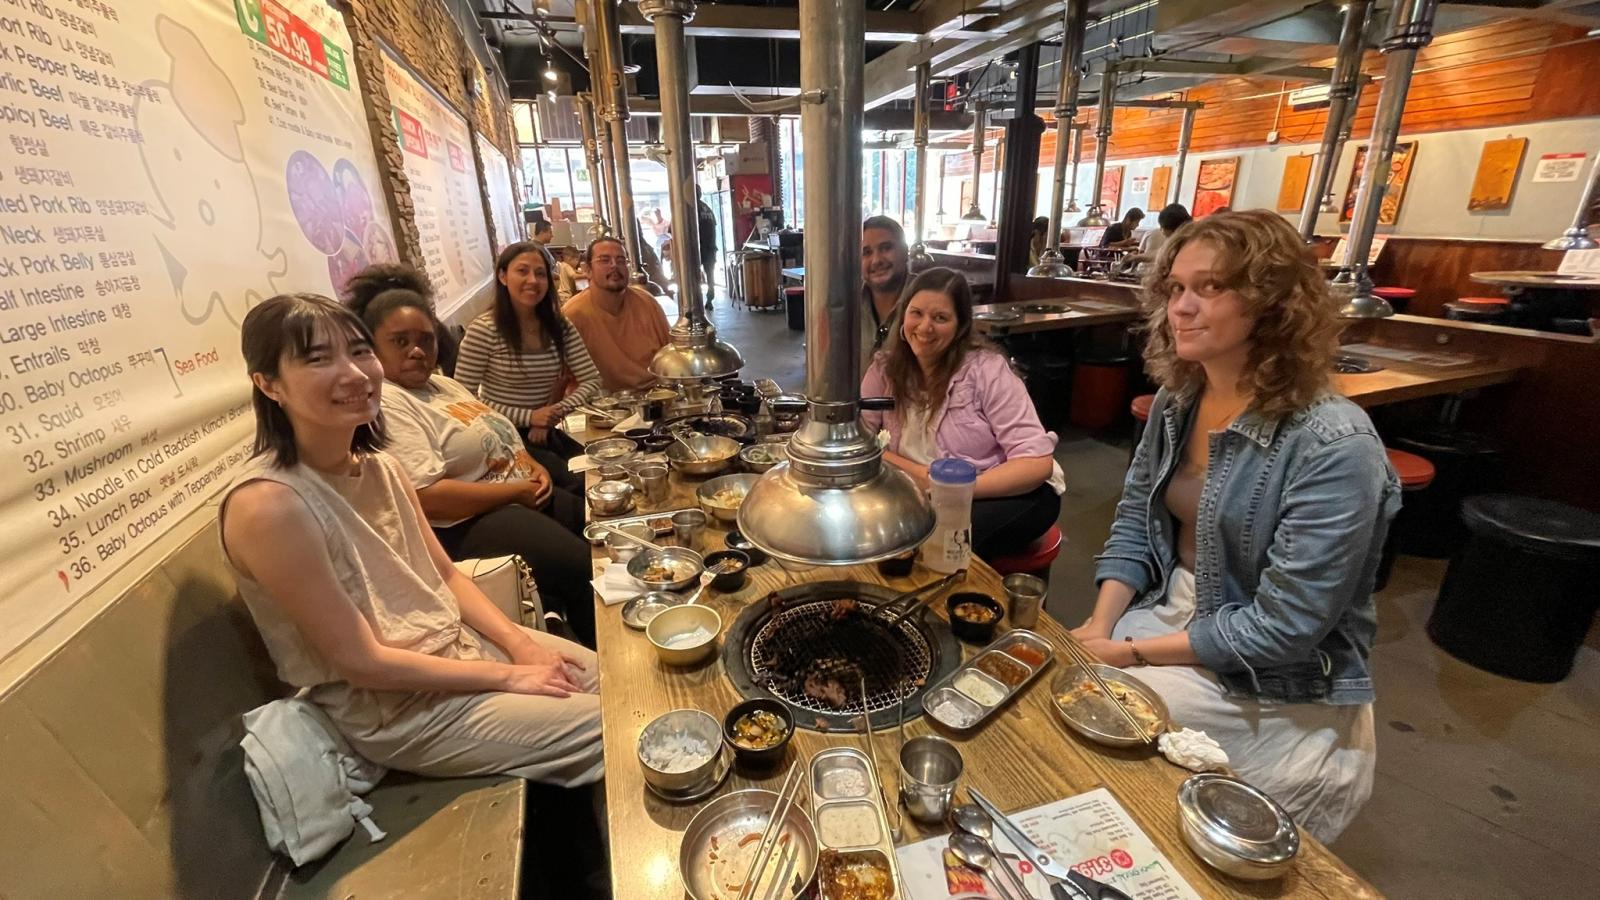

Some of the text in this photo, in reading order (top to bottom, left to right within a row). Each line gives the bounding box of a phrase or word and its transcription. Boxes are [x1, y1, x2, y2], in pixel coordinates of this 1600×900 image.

[0, 17, 25, 38] ort
[25, 21, 52, 46] Rib
[58, 35, 75, 54] LA
[264, 14, 313, 67] 56.99
[14, 44, 68, 77] Pepper
[28, 78, 64, 103] Beef
[611, 72, 620, 87] 3
[38, 108, 74, 131] Beef
[0, 194, 29, 213] ted
[30, 194, 65, 214] Pork
[68, 196, 92, 215] Rib
[0, 225, 46, 244] Neck
[20, 254, 60, 275] Pork
[59, 252, 94, 272] Belly
[20, 283, 85, 307] Intestine
[0, 303, 132, 344] Large Intestine 대창
[10, 337, 101, 374] Entrails 막창
[174, 347, 219, 376] Sea Food
[24, 379, 66, 404] Baby
[68, 361, 124, 390] Octopus
[6, 388, 126, 445] 31. Squid 오징어
[22, 451, 54, 474] 32.
[54, 428, 106, 460] Shrimp
[34, 479, 61, 502] 33.
[64, 443, 133, 486] Mushroom
[47, 505, 77, 528] 34.
[75, 475, 125, 512] Noodle
[125, 466, 139, 483] in
[138, 447, 164, 474] Cold
[163, 428, 201, 459] Raddish
[58, 532, 85, 555] 35.
[86, 502, 128, 537] Lunch
[129, 488, 153, 510] Box
[70, 556, 97, 580] 36.
[96, 531, 127, 562] Baby
[127, 505, 169, 539] Octopus
[167, 490, 186, 510] with
[184, 459, 227, 499] Teppanyaki
